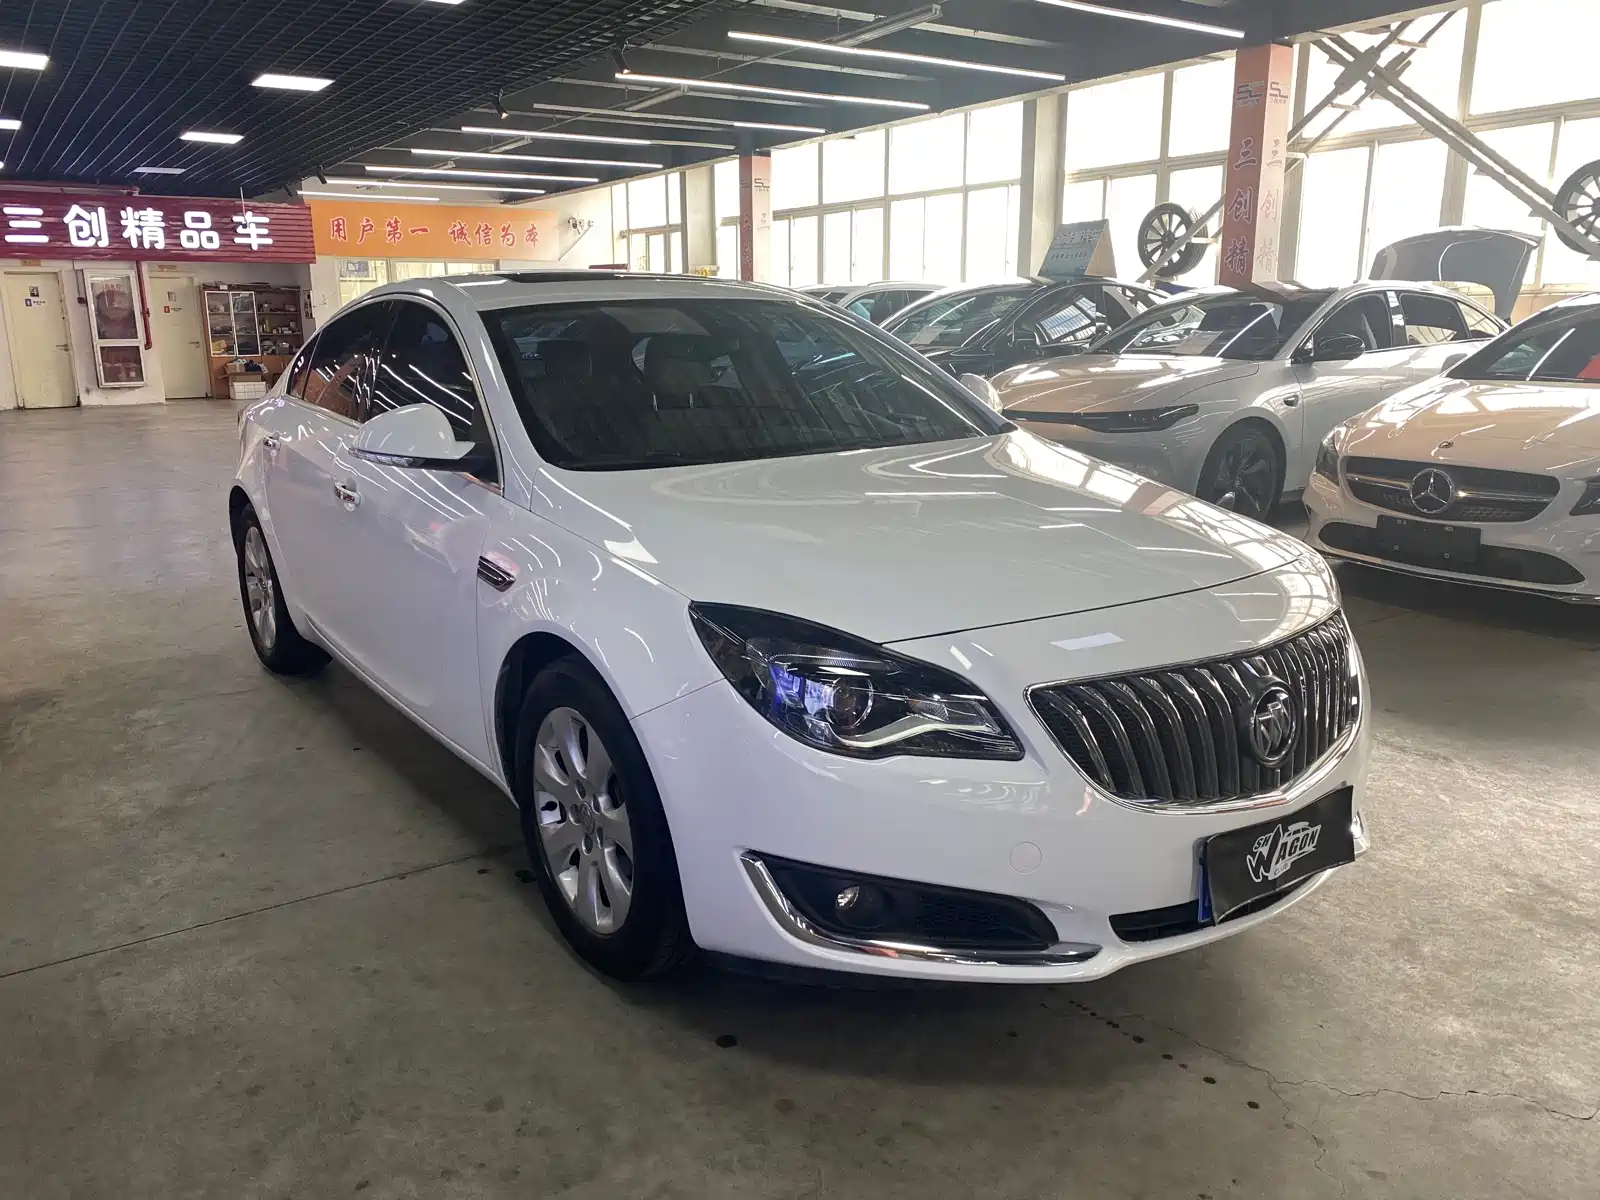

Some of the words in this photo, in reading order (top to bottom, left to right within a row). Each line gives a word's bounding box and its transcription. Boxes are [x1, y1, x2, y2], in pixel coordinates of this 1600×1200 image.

[2, 203, 274, 251] 三创精品车
[329, 216, 431, 245] 用户第一
[449, 220, 541, 248] 诚信为本
